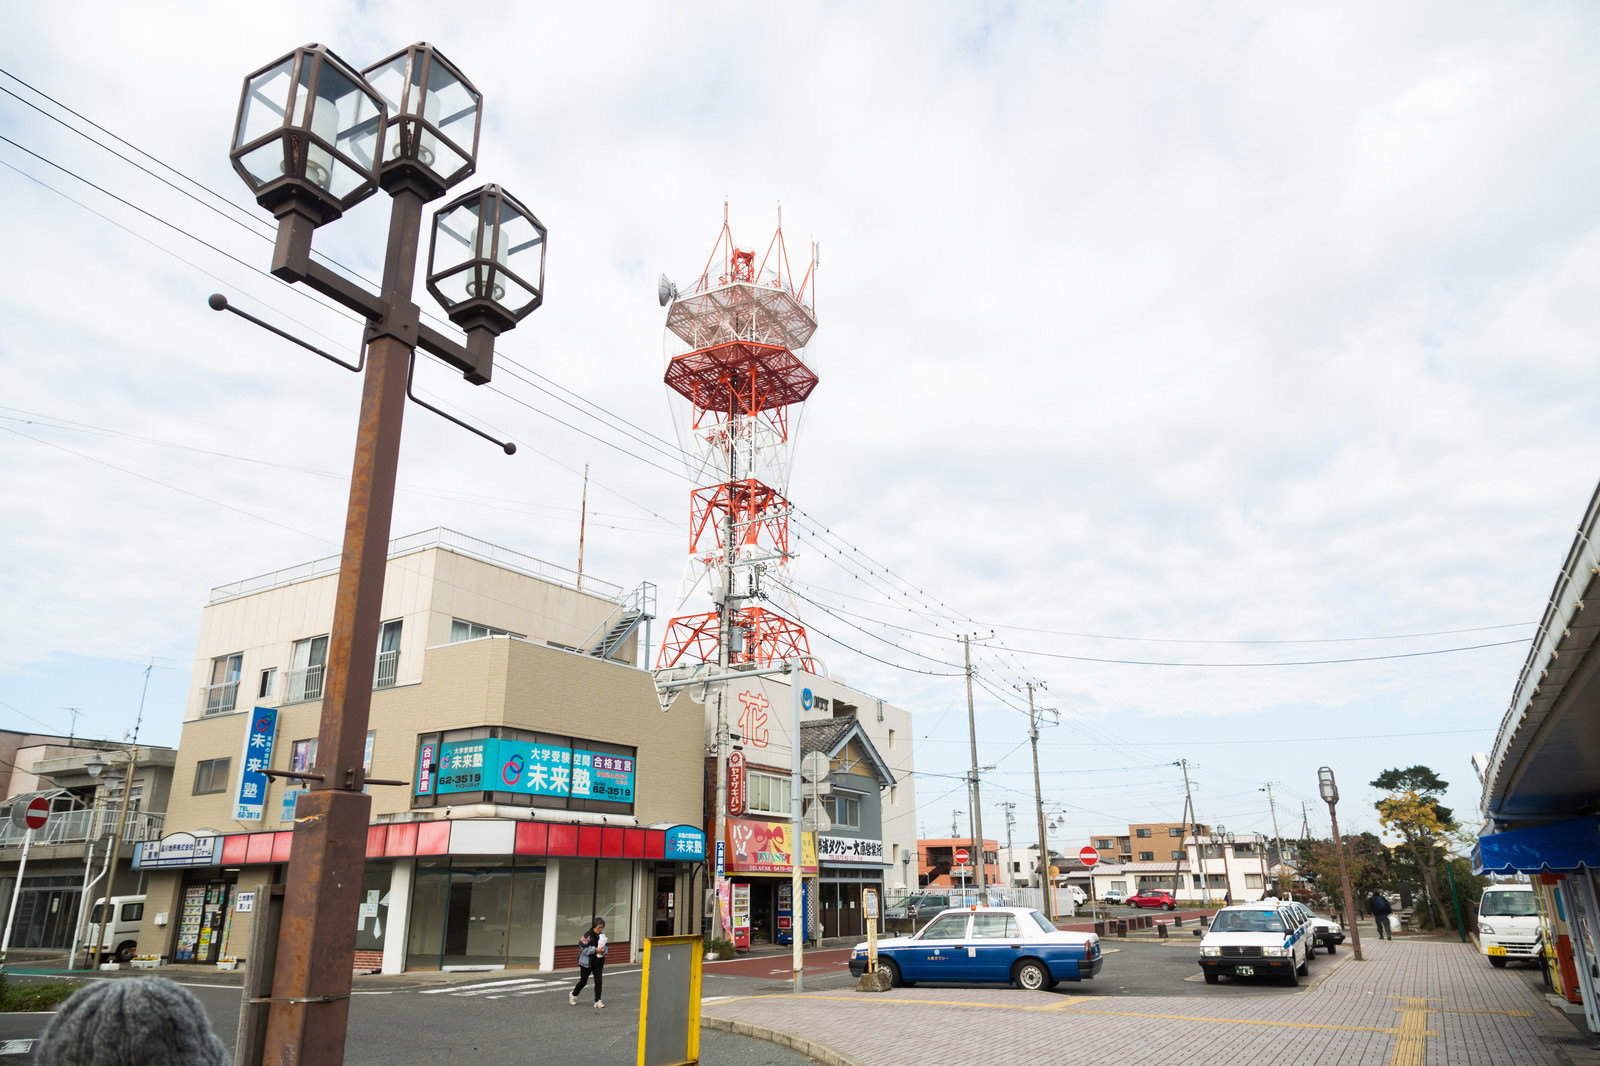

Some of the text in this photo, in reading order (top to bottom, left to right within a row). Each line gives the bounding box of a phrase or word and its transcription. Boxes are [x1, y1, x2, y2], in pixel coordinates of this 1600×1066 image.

[813, 695, 829, 711] NTT
[738, 690, 769, 748] 花
[241, 733, 266, 798] 未来塾
[451, 752, 483, 769] 未来塾
[531, 747, 591, 767] 大学受験空間
[593, 756, 632, 772] 合格宣言
[439, 773, 481, 785] 62-3519
[527, 762, 591, 795] 未来塾
[592, 785, 631, 797] 62-3519
[732, 822, 753, 840] パン
[676, 839, 703, 853] 未来塾
